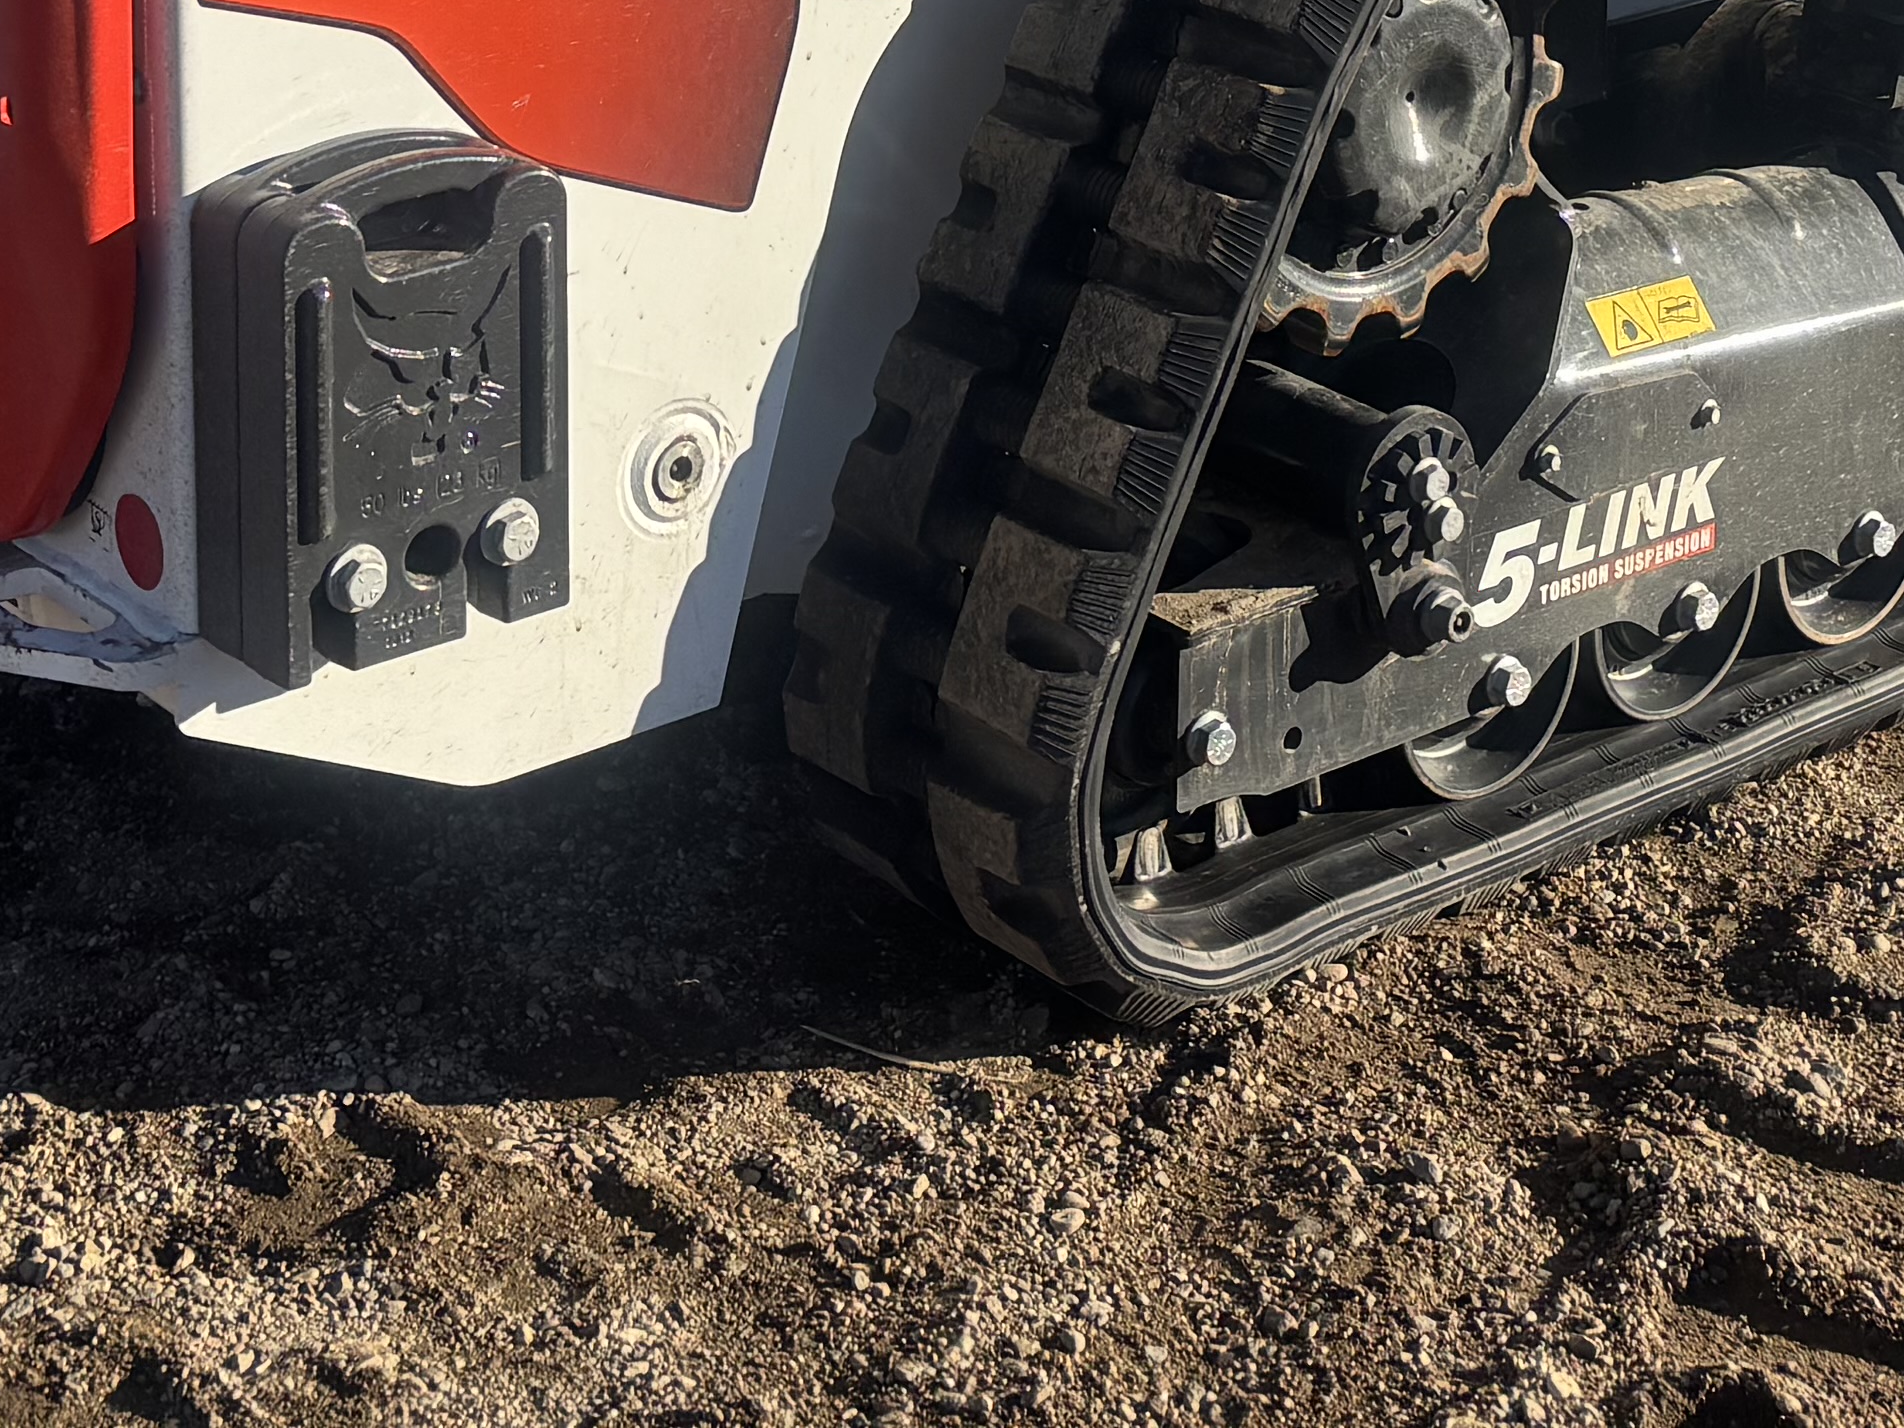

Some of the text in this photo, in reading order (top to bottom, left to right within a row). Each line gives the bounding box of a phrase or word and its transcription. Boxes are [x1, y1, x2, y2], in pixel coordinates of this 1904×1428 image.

[1472, 456, 1726, 628] 5-LINK
[1539, 530, 1712, 605] TORSION SUSPENSION
